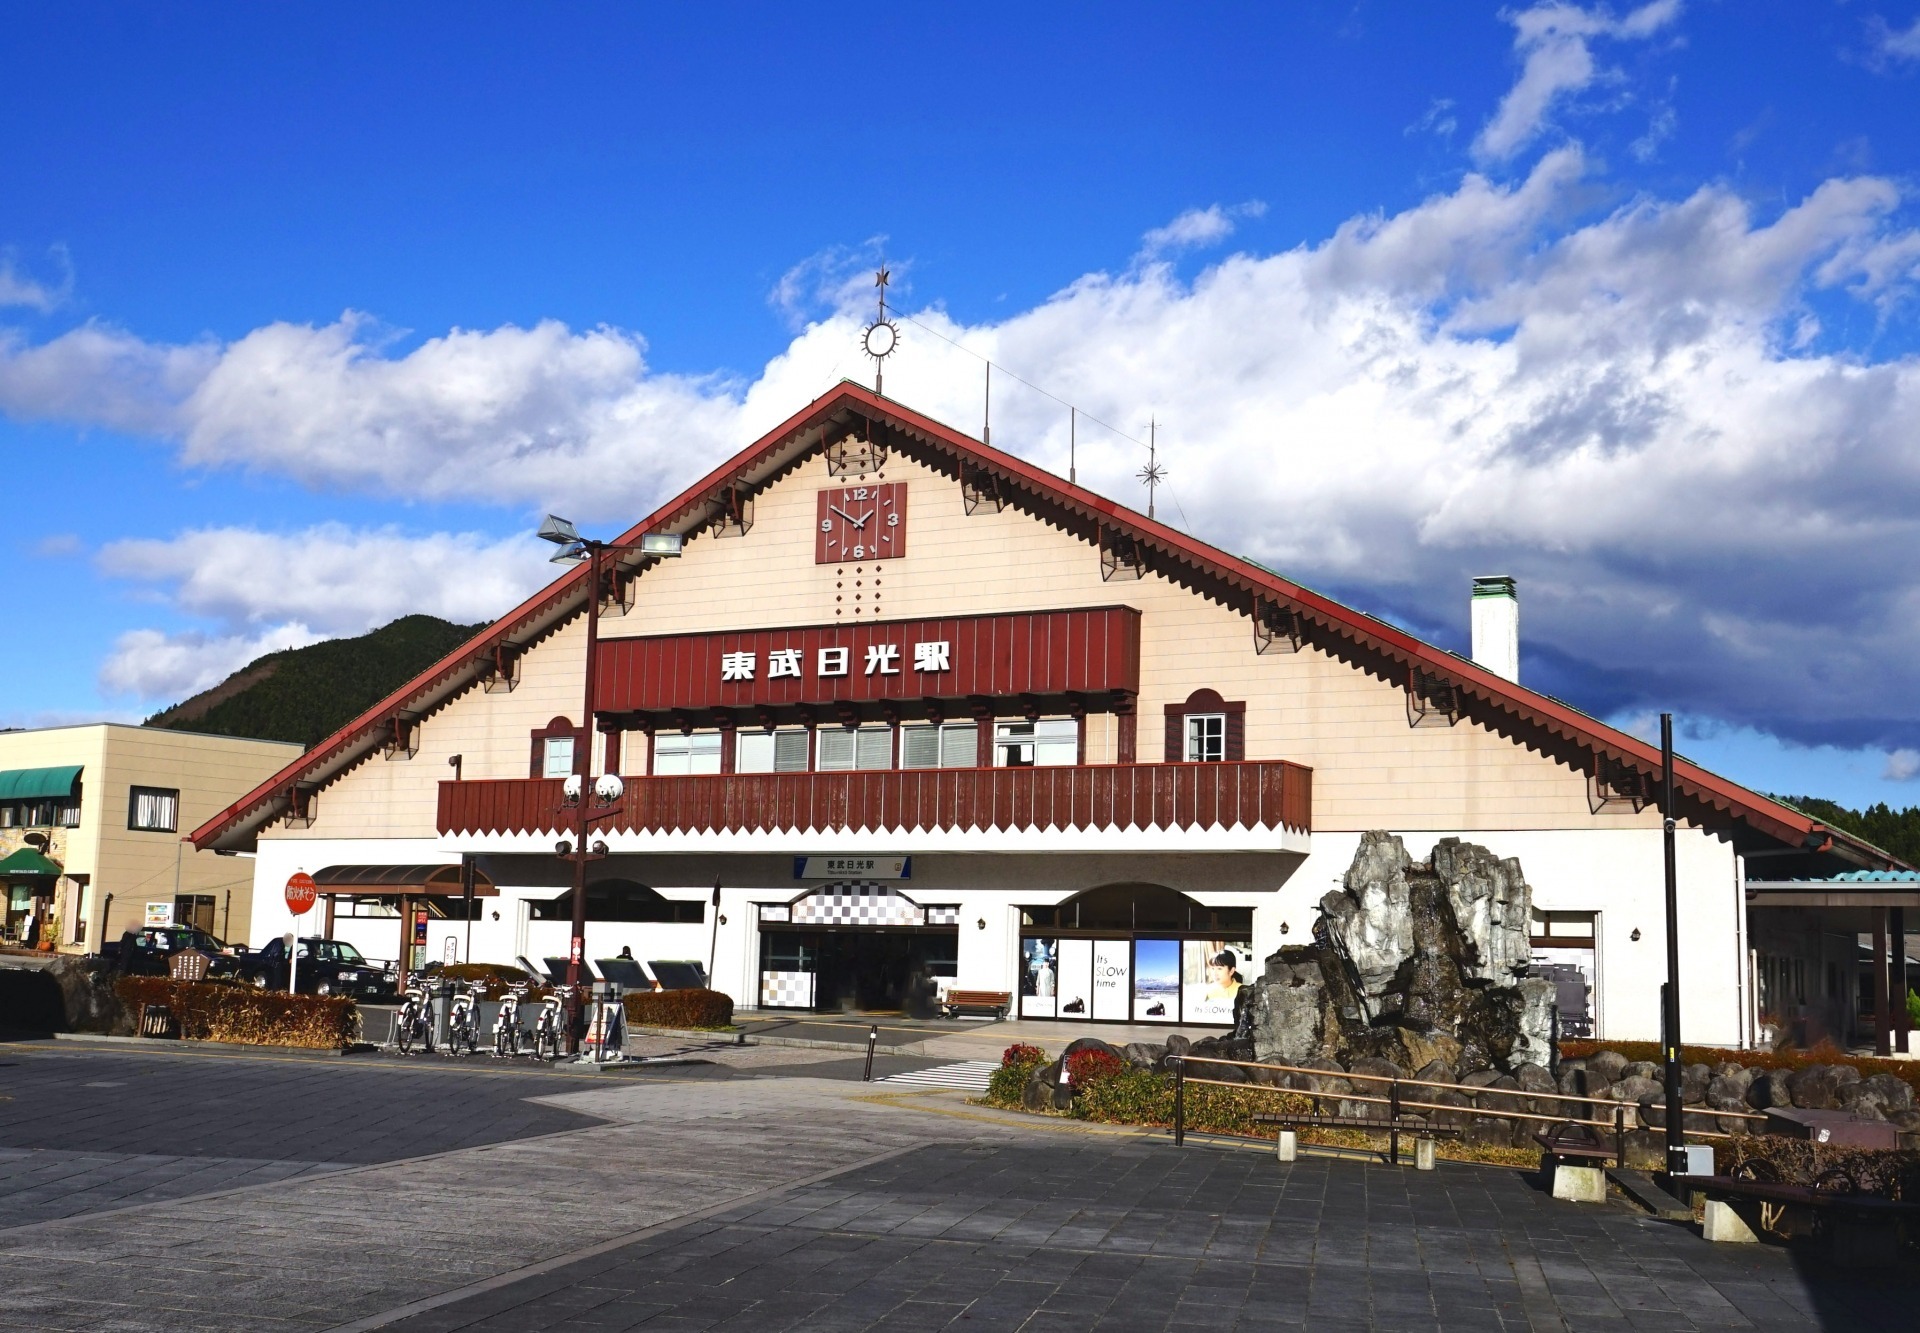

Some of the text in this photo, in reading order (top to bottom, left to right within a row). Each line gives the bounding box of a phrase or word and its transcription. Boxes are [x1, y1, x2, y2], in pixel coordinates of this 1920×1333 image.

[853, 488, 867, 501] 12
[821, 519, 832, 532] 9
[888, 513, 899, 527] 3
[853, 546, 864, 559] 6
[721, 641, 950, 681] 東武日光駅
[827, 860, 875, 870] 東武日光駅
[1096, 966, 1128, 977] SLOW
[1096, 979, 1116, 988] time
[1204, 1006, 1227, 1014] SLOW
